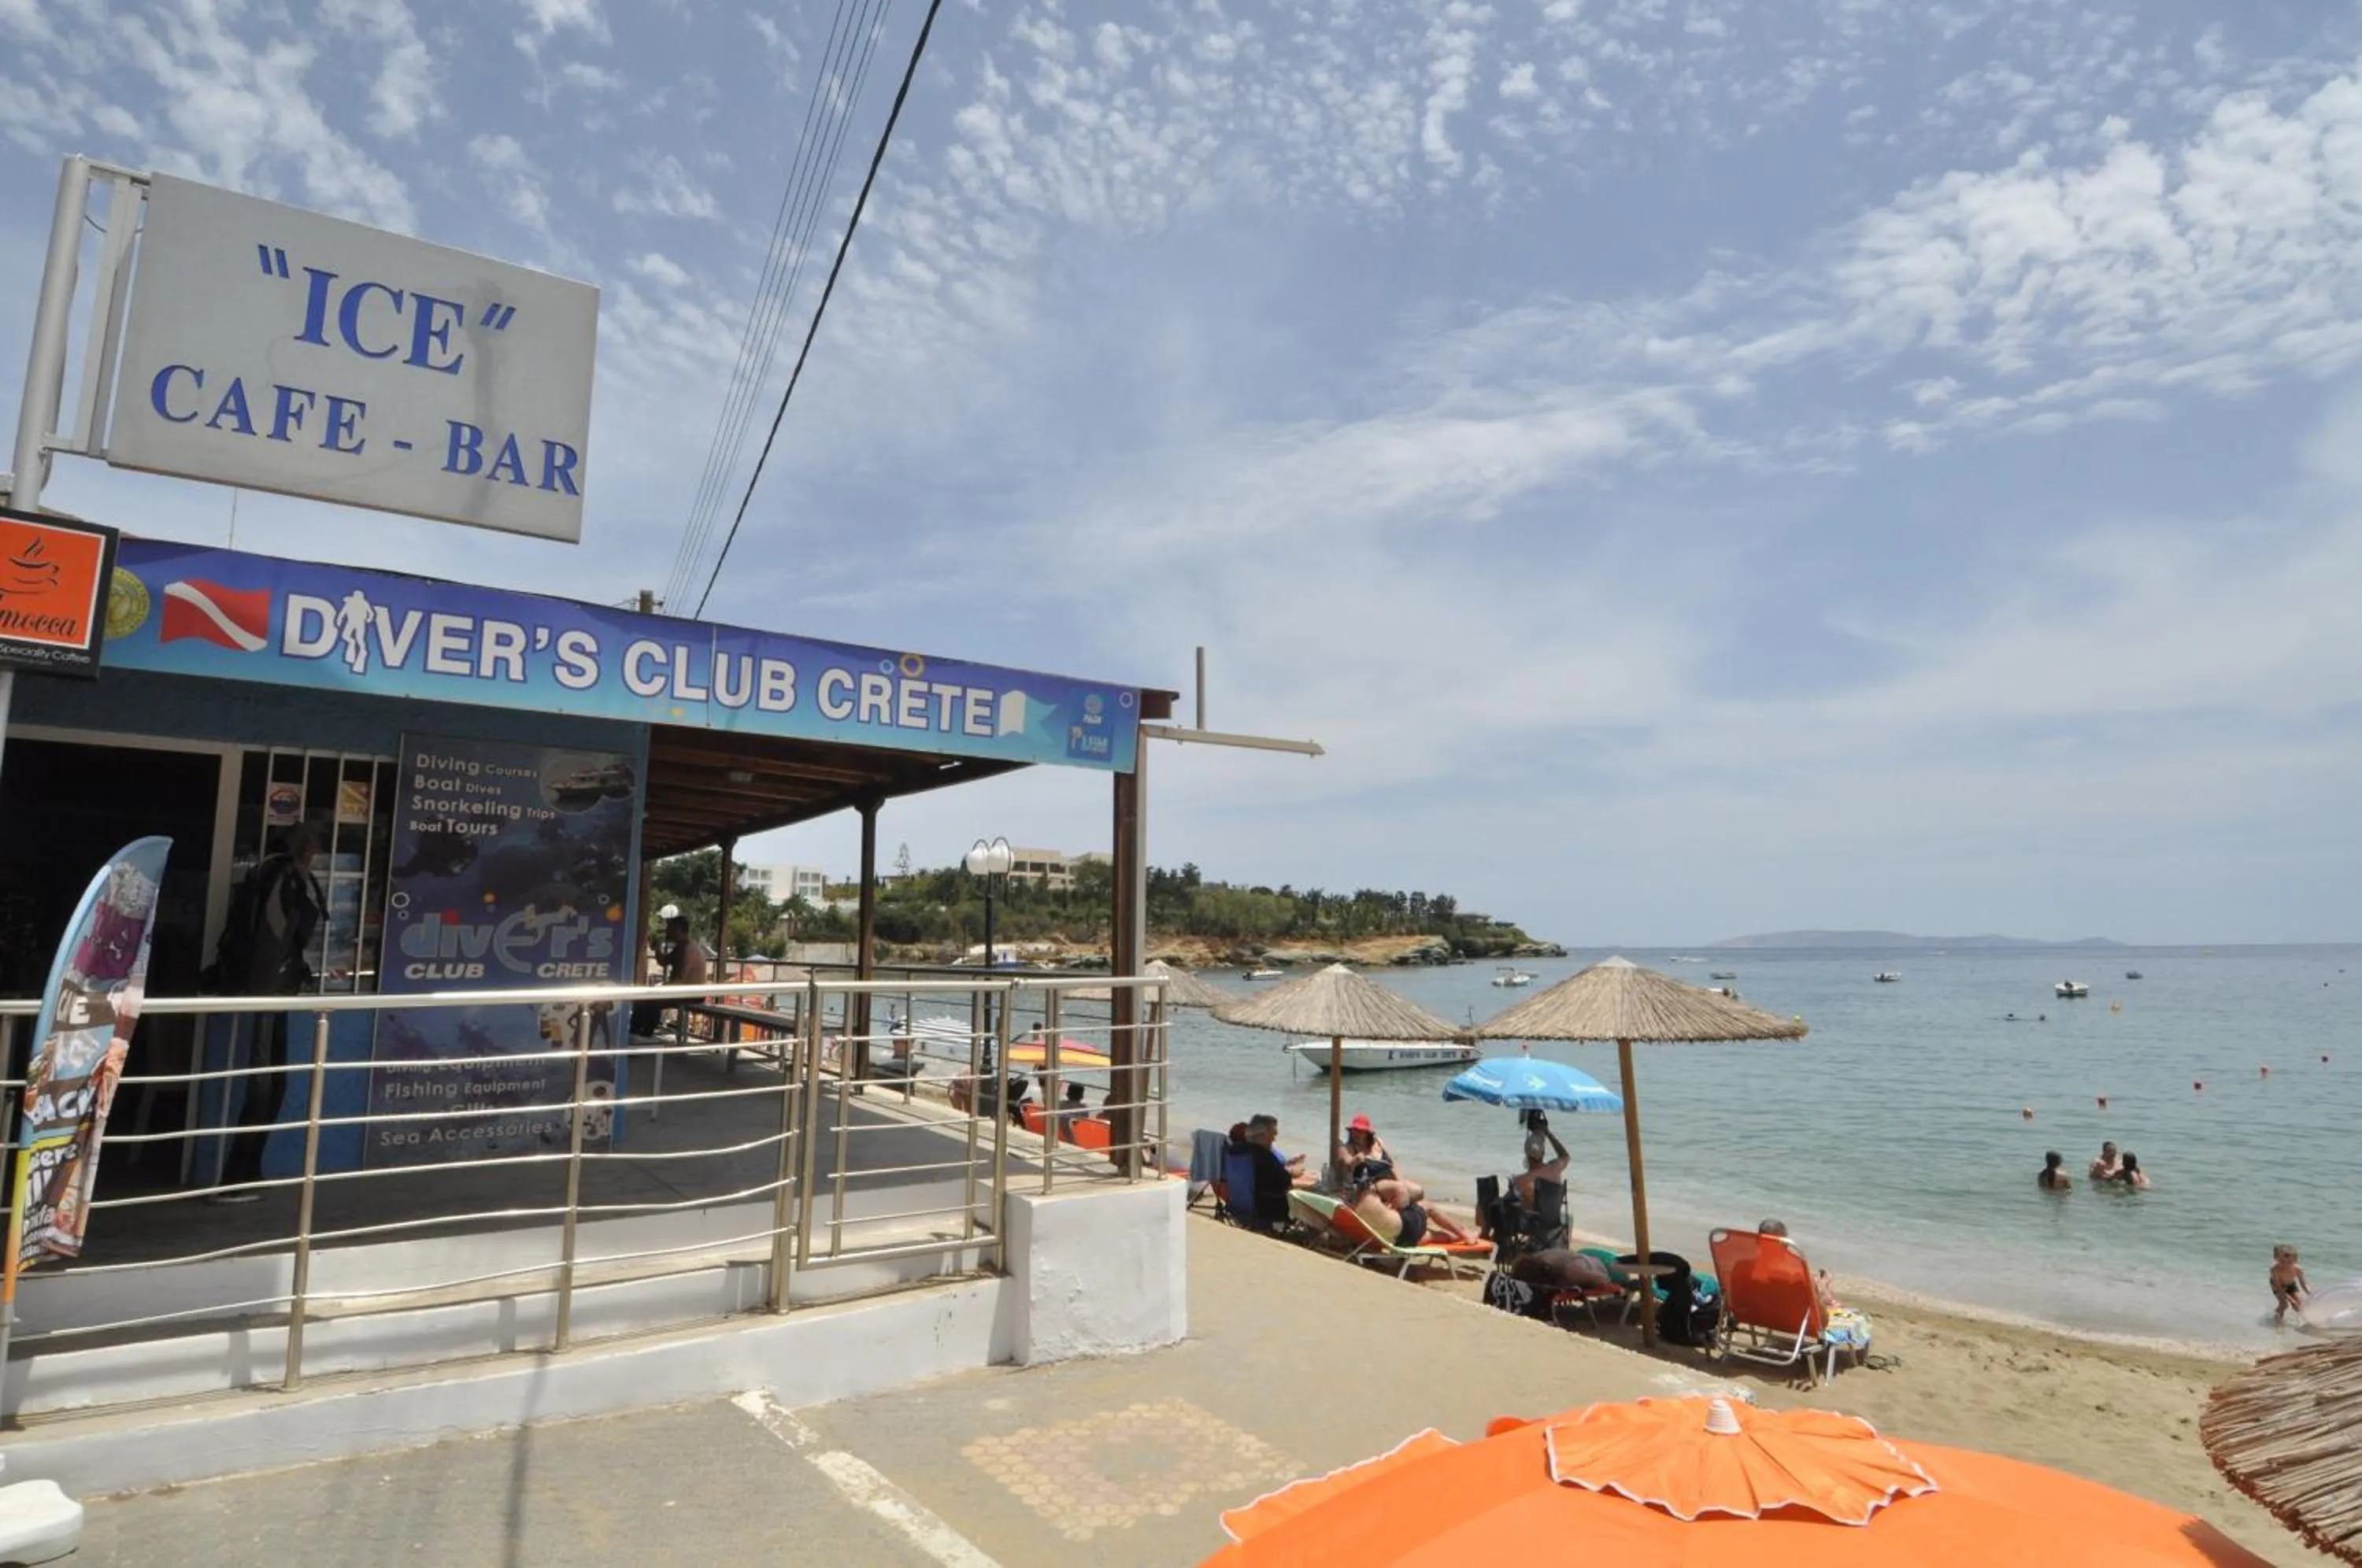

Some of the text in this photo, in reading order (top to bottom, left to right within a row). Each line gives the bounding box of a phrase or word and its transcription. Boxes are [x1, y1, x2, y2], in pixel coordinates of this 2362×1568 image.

[150, 364, 367, 455] CAFE
[441, 419, 580, 496] BAR
[622, 639, 798, 712] CLUB
[816, 667, 994, 737] CRETE
[416, 753, 538, 778] Diving Courses
[414, 775, 502, 795] Boat Dives
[411, 795, 556, 819] Snorkeling Trips
[409, 818, 499, 836] Boat Tours
[404, 962, 610, 980] CLUB CRETE
[384, 1078, 546, 1099] Fishing Equipment
[379, 1130, 421, 1146] Sea
